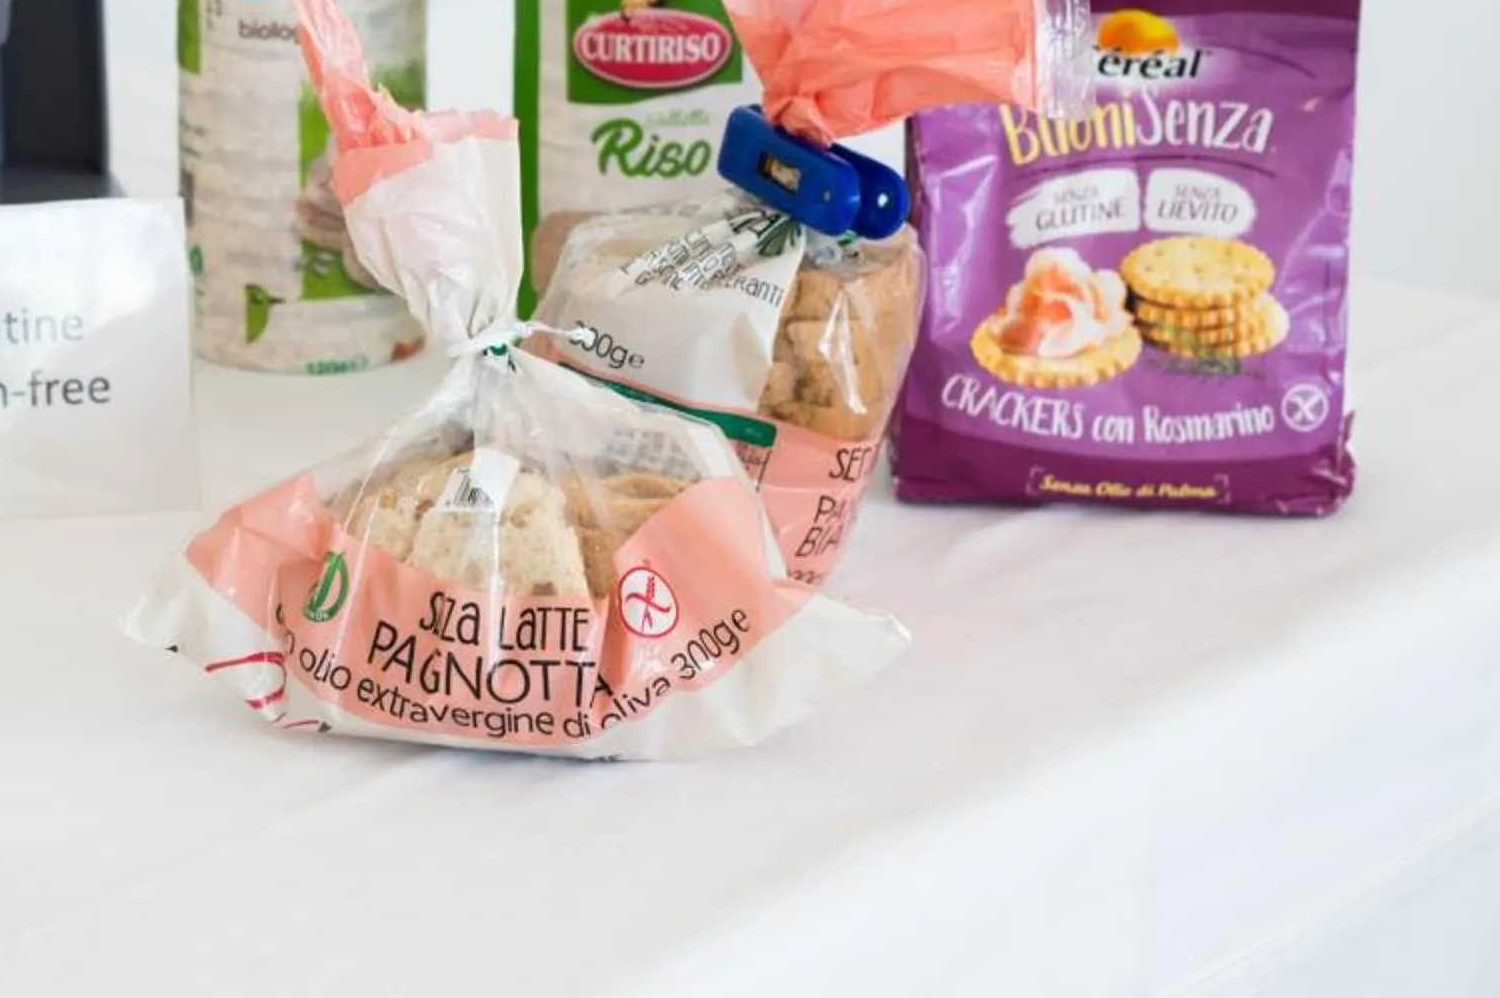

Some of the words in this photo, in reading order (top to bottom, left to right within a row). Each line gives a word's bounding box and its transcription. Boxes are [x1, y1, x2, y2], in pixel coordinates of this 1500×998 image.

[581, 33, 721, 64] CURTIRISO
[1093, 45, 1203, 80] éréal
[591, 118, 712, 178] Riso
[1035, 198, 1128, 231] GLUTINE
[1157, 200, 1239, 223] LIEVITO
[941, 373, 1085, 439] CRACKERS
[1092, 413, 1135, 443] con
[1142, 404, 1275, 444] Rosmarino
[367, 620, 614, 708] PAGNOTTA
[300, 647, 351, 690] olio
[357, 678, 555, 738] extravergine
[563, 711, 591, 738] di
